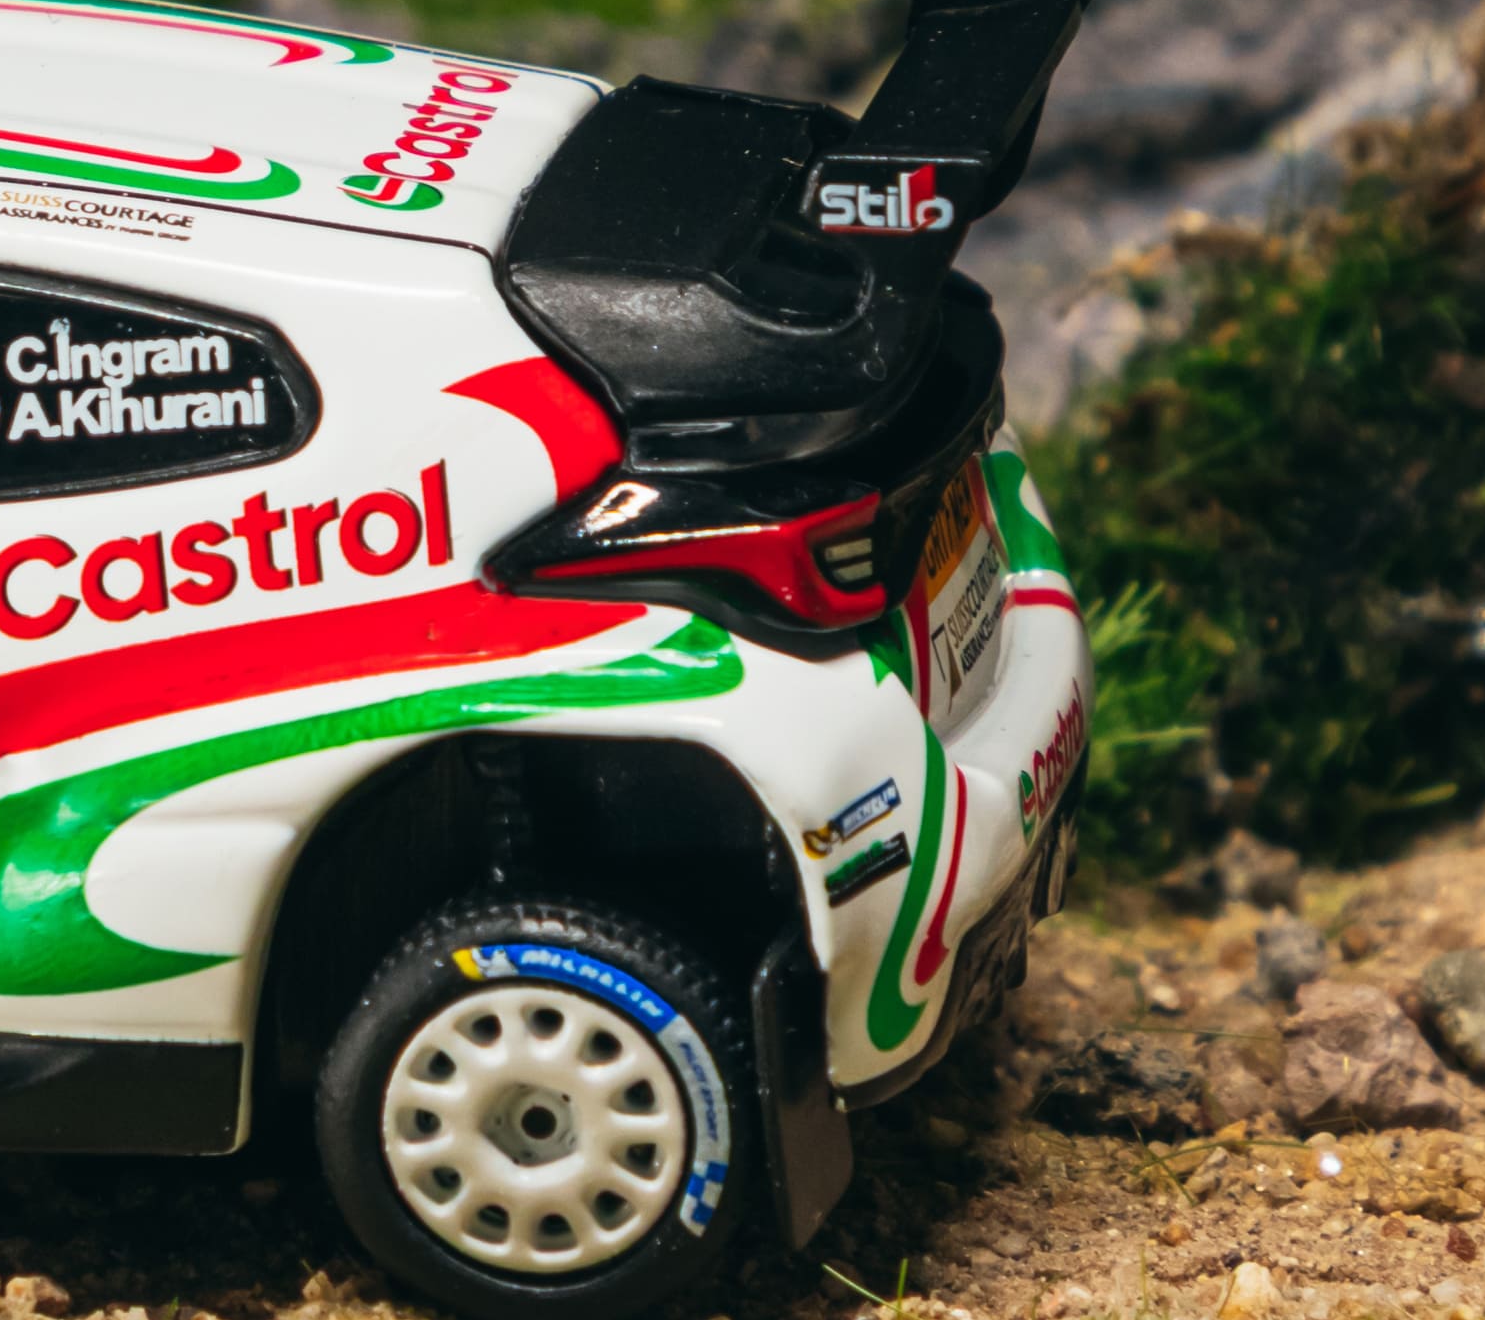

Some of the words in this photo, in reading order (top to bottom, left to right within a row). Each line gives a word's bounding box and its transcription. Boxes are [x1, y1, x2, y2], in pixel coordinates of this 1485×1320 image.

[363, 59, 519, 182] Castrol
[0, 189, 195, 228] SUISSCOURTAGE
[821, 163, 953, 231] Stilo
[5, 321, 230, 388] C.Ingram
[7, 378, 267, 441] A.Kihurani
